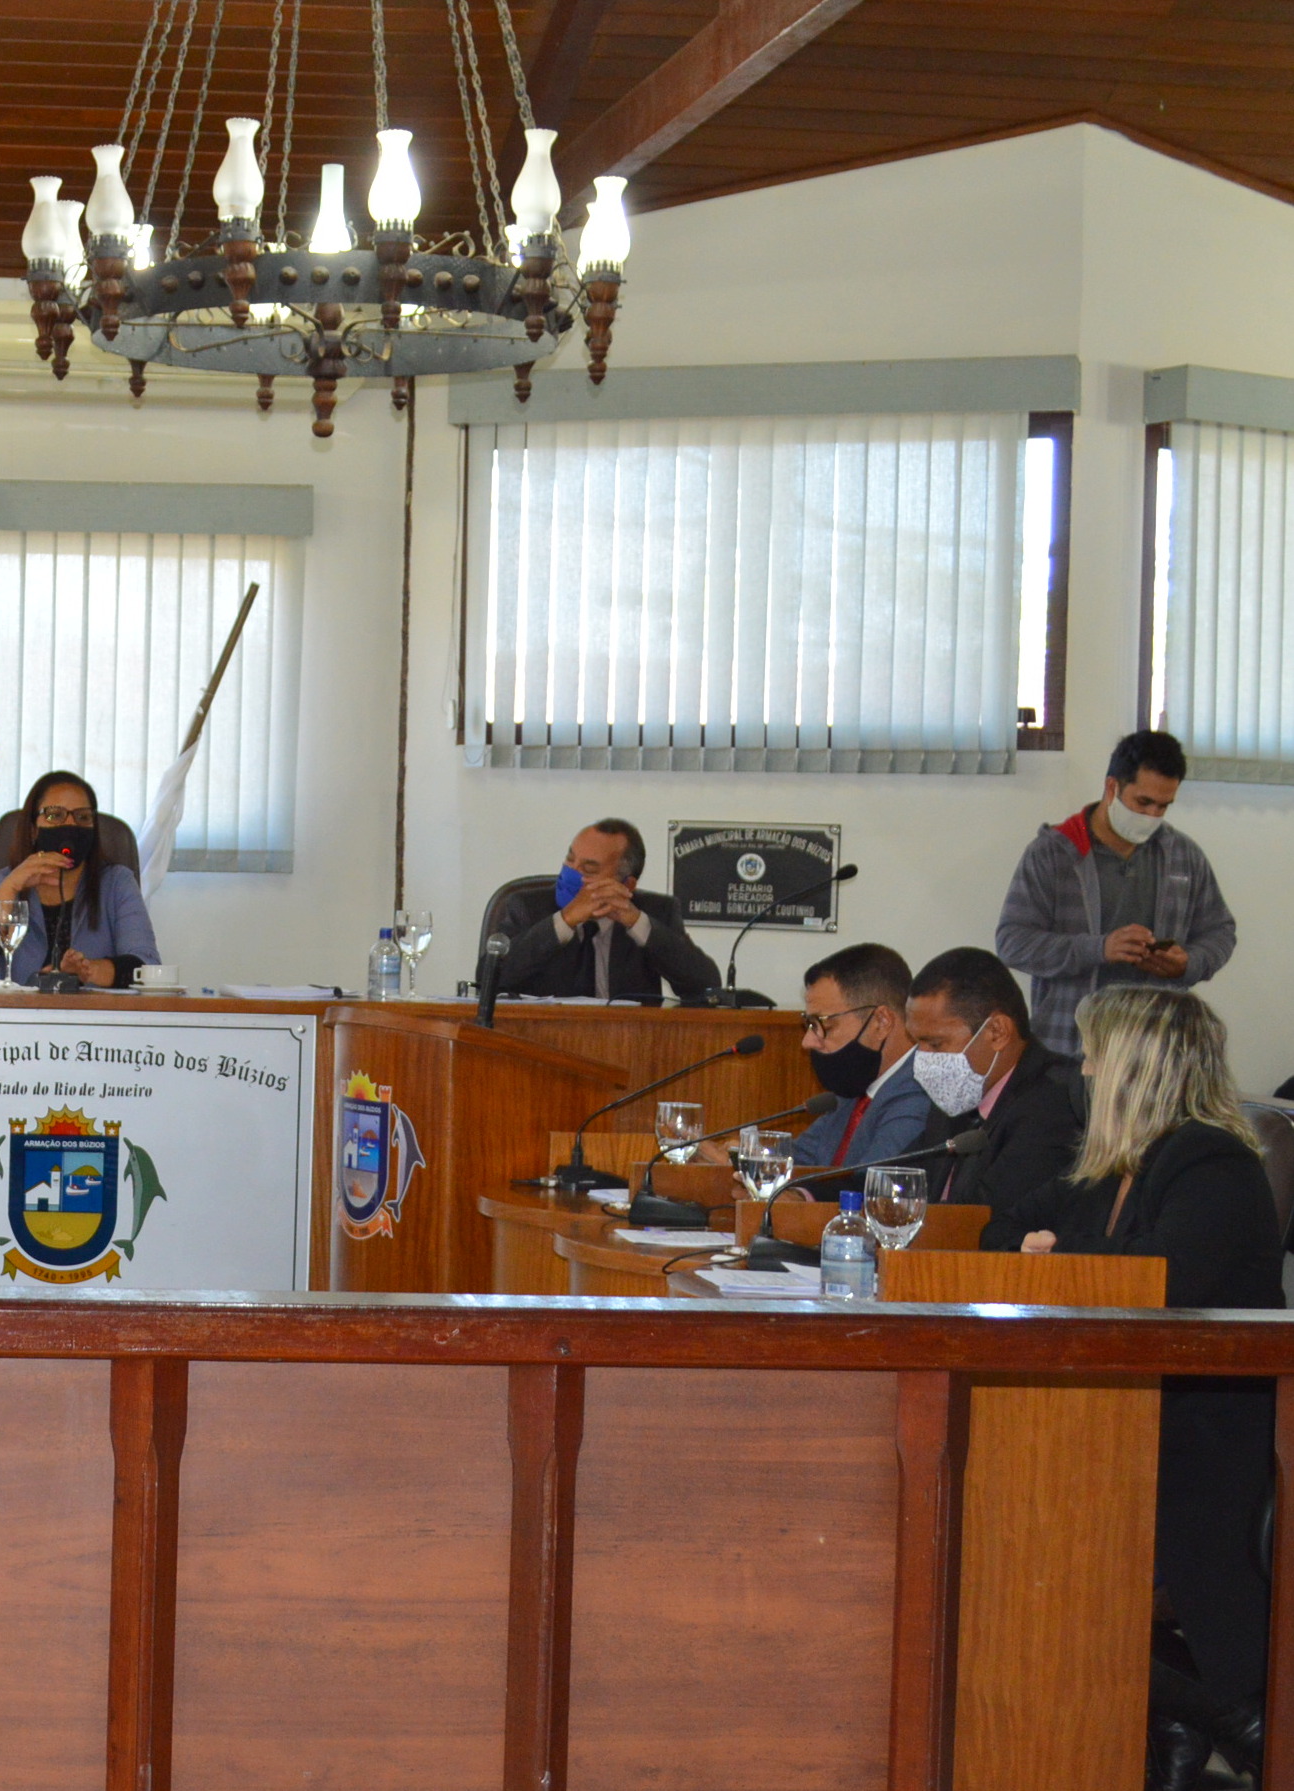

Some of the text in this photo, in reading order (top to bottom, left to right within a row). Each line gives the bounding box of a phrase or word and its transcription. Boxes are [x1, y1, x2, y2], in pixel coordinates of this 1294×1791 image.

[674, 836, 705, 858] CÂMARA
[704, 829, 742, 846] MUNICIPAL
[745, 828, 755, 841] DE
[755, 828, 791, 846] ARMAÇÃO
[791, 835, 807, 851] DOS
[728, 882, 773, 893] PLENÁRIO
[727, 892, 774, 902] VEREADOR
[775, 904, 815, 917] COUTINHO
[49, 1041, 70, 1061] de
[75, 1040, 165, 1072] Armação
[174, 1050, 208, 1073] dos
[215, 1054, 290, 1092] Búzios
[33, 1081, 49, 1096] do
[54, 1081, 77, 1096] Rio
[78, 1082, 95, 1096] de
[99, 1082, 153, 1099] Janeiro
[24, 1139, 105, 1149] ARMAÇÃO DOS BÚZIOS
[33, 1268, 93, 1281] 1740 1995
